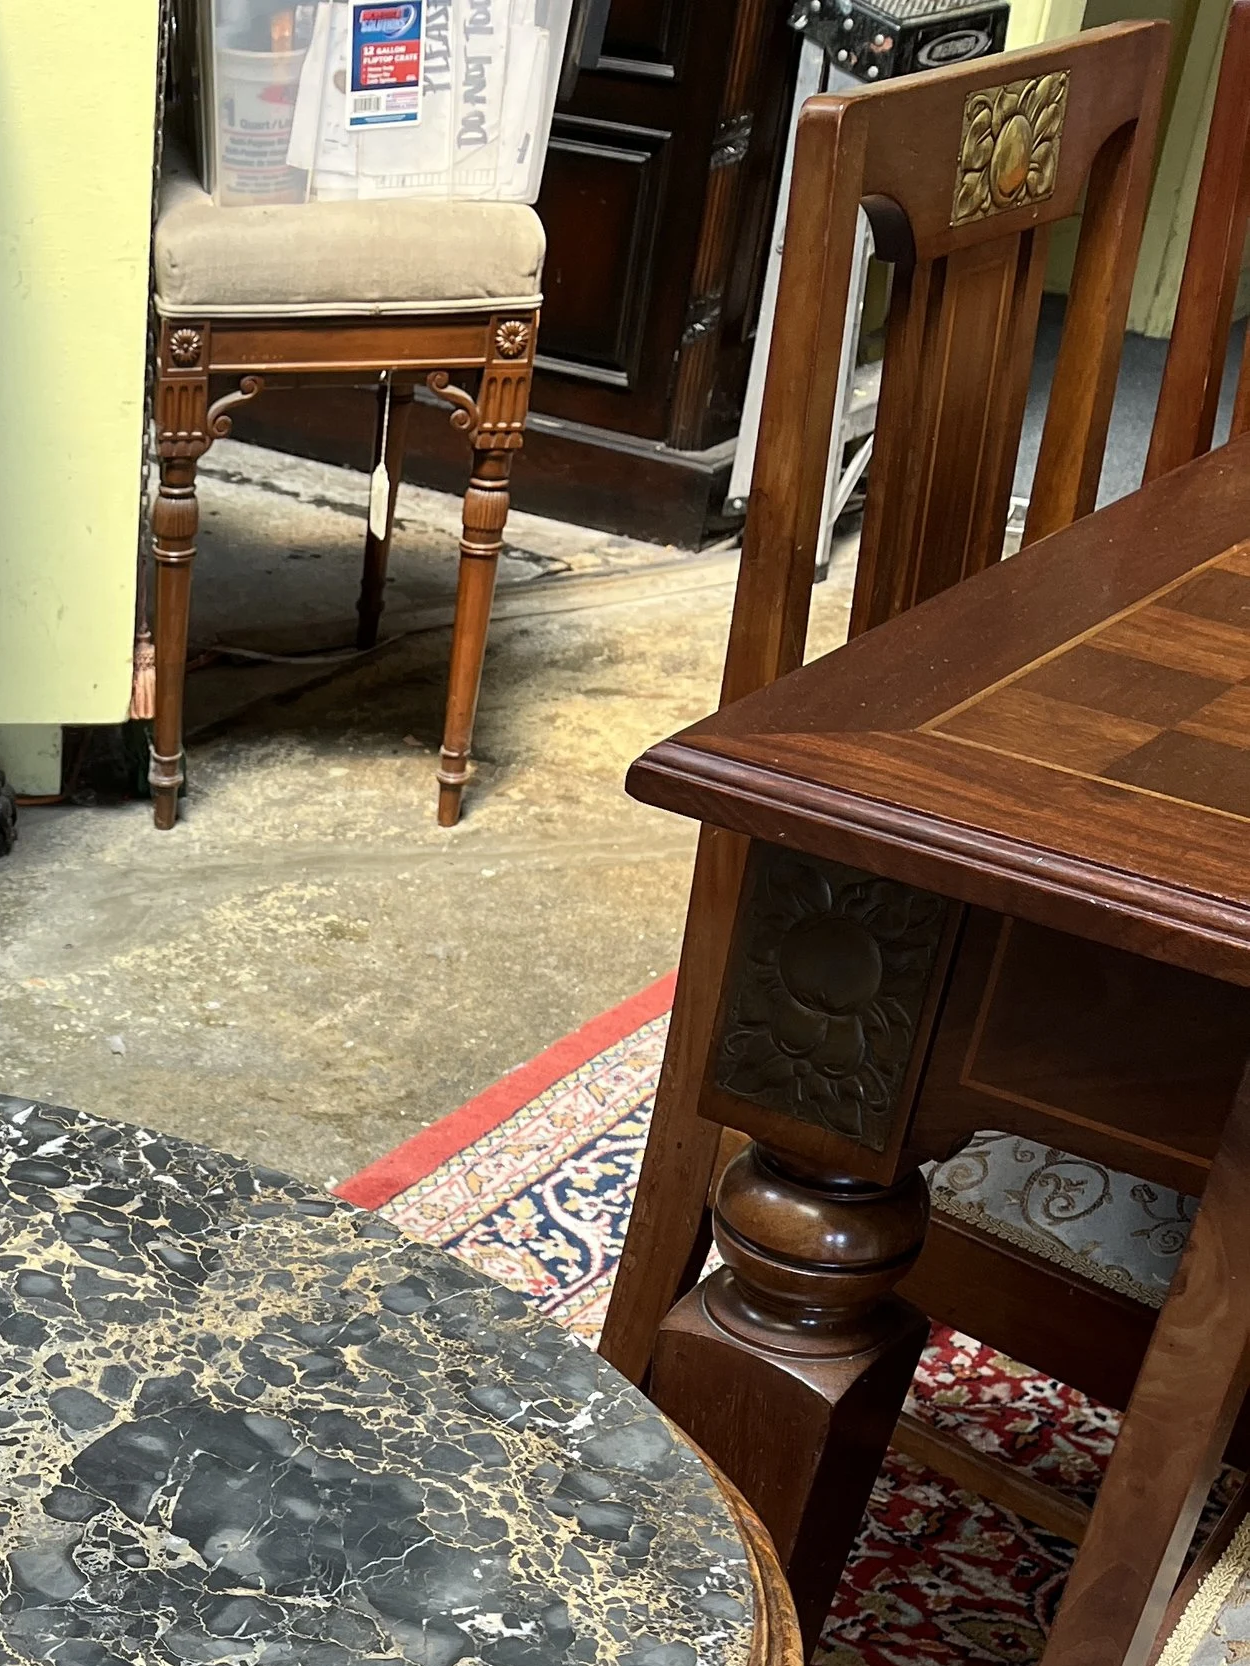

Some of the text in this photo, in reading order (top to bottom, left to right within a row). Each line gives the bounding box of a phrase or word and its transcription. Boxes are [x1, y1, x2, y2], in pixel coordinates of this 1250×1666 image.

[363, 45, 406, 56] 12 GALLON
[363, 52, 418, 65] FLIPTOP CRATE
[462, 44, 492, 105] NOT
[457, 110, 488, 149] DO
